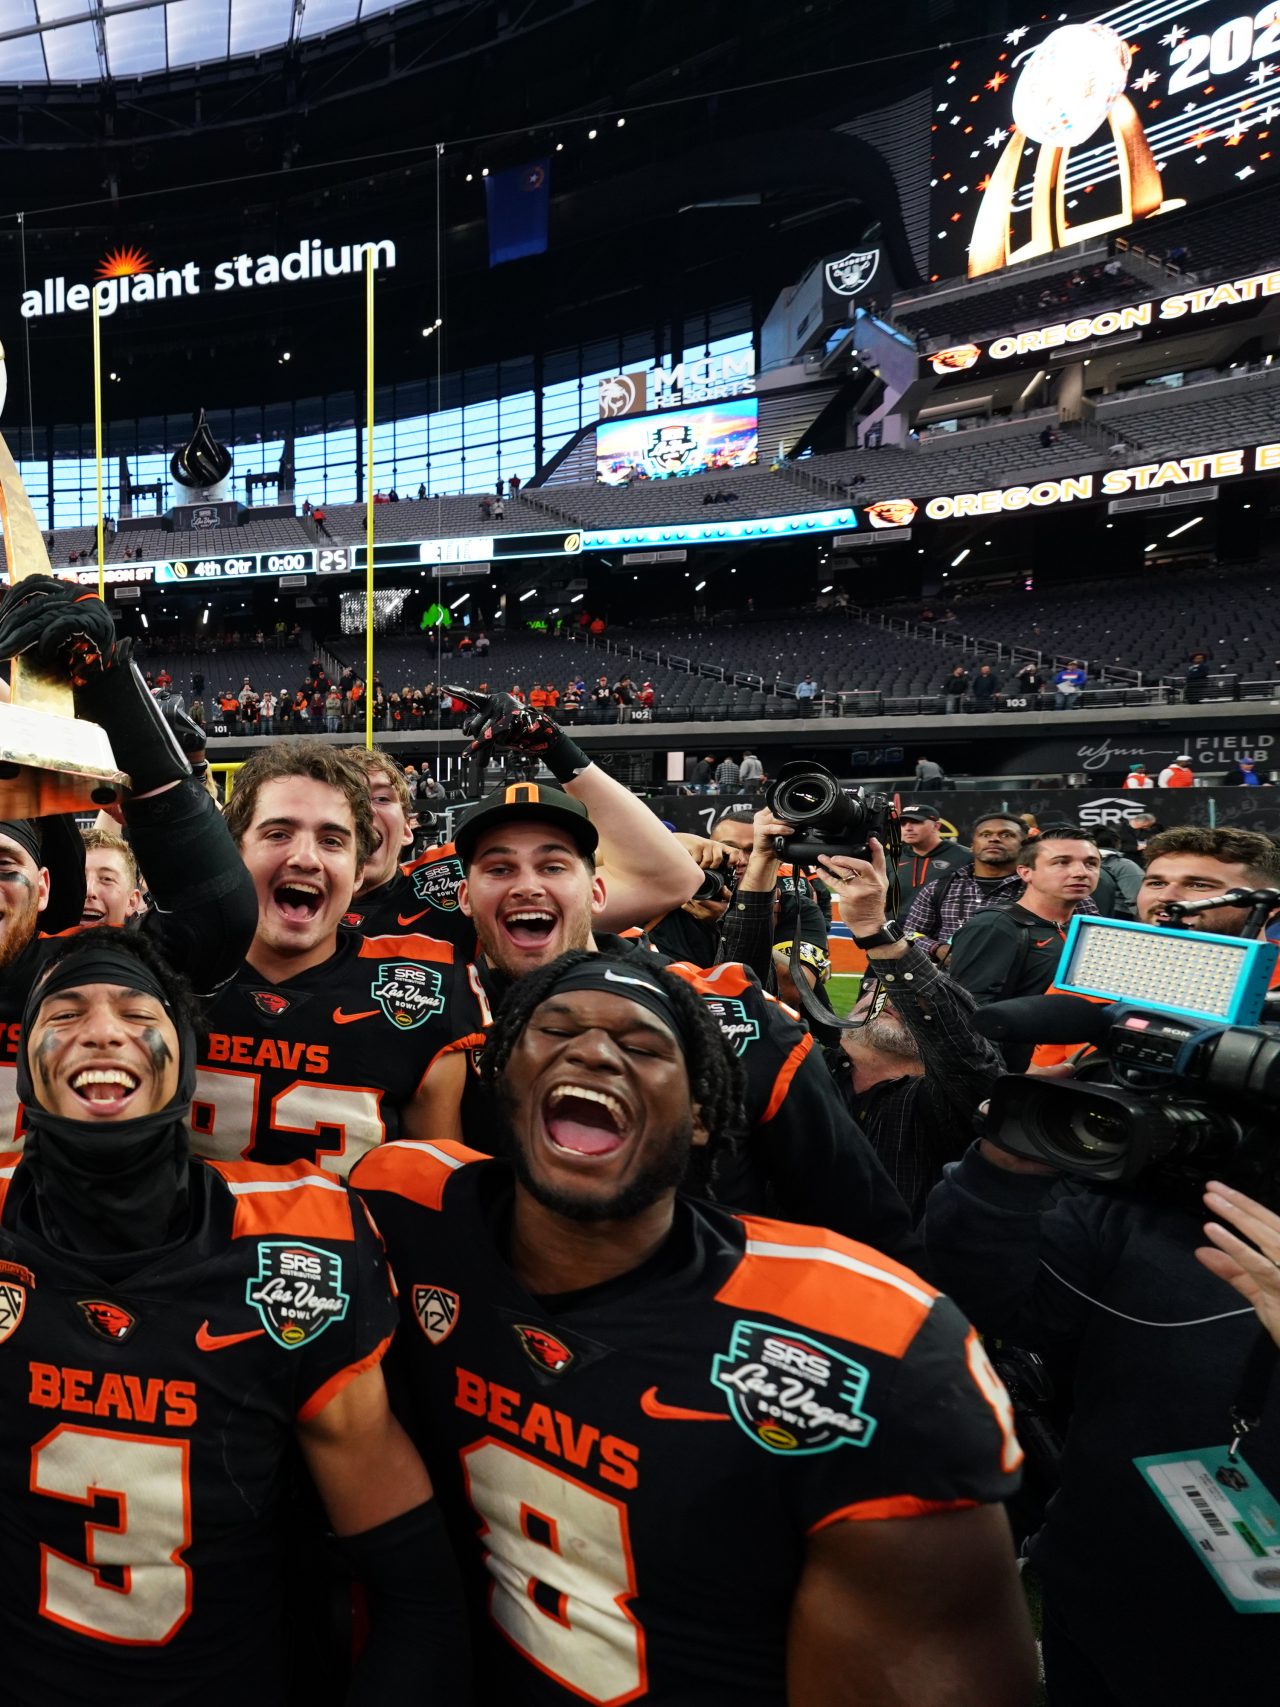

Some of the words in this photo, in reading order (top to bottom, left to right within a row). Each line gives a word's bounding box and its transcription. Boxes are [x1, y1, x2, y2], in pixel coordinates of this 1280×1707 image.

[831, 254, 873, 270] RAIDERS
[20, 261, 200, 318] allegiant
[214, 239, 396, 292] stadium
[988, 302, 1152, 360] OREGON
[1159, 270, 1280, 321] STATE
[653, 349, 755, 393] MGM
[653, 378, 757, 409] RESORTS
[926, 475, 1093, 521] OREGON
[1102, 450, 1244, 494] STATE
[194, 560, 221, 578] 4th
[224, 558, 253, 576] Qtr
[268, 554, 305, 572] 0:00
[320, 550, 348, 572] 25
[78, 569, 135, 585] ORGON
[136, 567, 153, 582] ST
[598, 688, 610, 698] 34
[1006, 698, 1027, 708] 103
[631, 711, 649, 719] 102
[214, 725, 228, 733] 101
[1196, 735, 1275, 749] FIELD
[1077, 738, 1165, 770] wynn
[1199, 750, 1268, 764] CLUB
[1079, 809, 1145, 827] SRS
[425, 865, 450, 878] SRS
[420, 881, 440, 896] Las
[438, 878, 462, 894] Veg
[394, 968, 426, 981] SRS
[376, 982, 404, 999] Las
[403, 985, 440, 1009] Vegas
[395, 1001, 417, 1011] BOWL
[719, 1019, 754, 1040] egas
[1162, 1026, 1192, 1037] SON
[208, 1033, 329, 1075] BEAVS
[280, 1252, 322, 1274] SRS
[252, 1278, 293, 1304] Las
[294, 1281, 343, 1318] Vegas
[281, 1306, 311, 1320] BOWL
[425, 1310, 444, 1333] 12
[764, 1337, 832, 1379] SRS
[29, 1361, 198, 1427] BEAVS
[720, 1363, 778, 1397] Las
[778, 1376, 864, 1432] Vegas
[758, 1400, 807, 1430] BOWL
[454, 1366, 640, 1490] BEAVS
[29, 1422, 193, 1647] 3
[459, 1435, 649, 1707] 8
